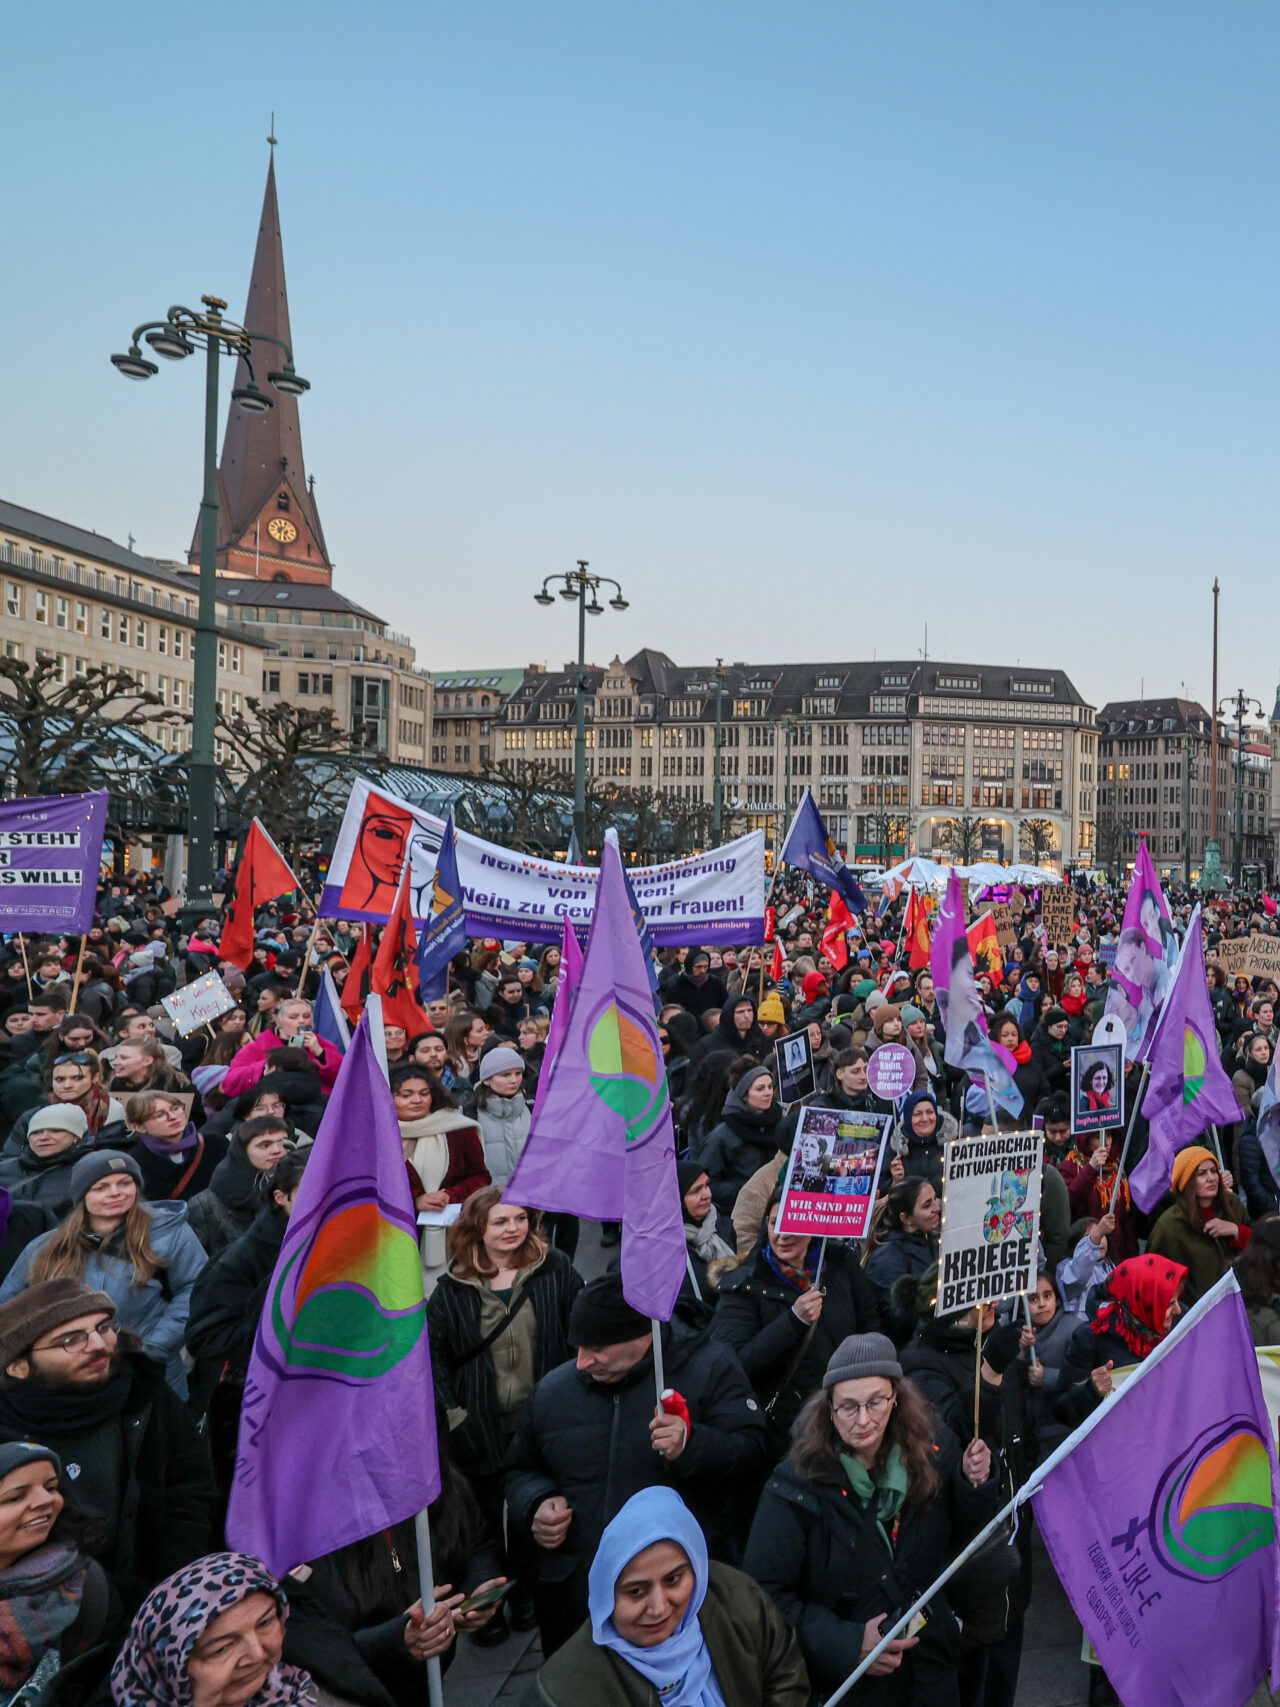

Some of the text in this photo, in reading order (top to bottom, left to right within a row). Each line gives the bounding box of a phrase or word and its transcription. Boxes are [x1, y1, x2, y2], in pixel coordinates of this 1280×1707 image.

[9, 832, 78, 845] STEHT
[20, 871, 80, 883] WILL!
[547, 887, 587, 900] von
[1043, 895, 1071, 904] UND
[461, 885, 510, 910] Nein
[518, 901, 546, 915] zu
[641, 904, 662, 917] an
[670, 895, 744, 915] Frauen!
[711, 921, 750, 929] Hamburg
[1043, 915, 1068, 925] DEM
[1221, 943, 1249, 957] RESPEC
[190, 1000, 221, 1020] Krieg
[951, 1136, 1041, 1162] PATRIARCHAT
[949, 1153, 1037, 1180] ENTWAFFNEN!
[790, 1199, 864, 1213] WIR SIND DIE
[787, 1210, 862, 1225] VERÄNDERUNG!
[944, 1237, 1032, 1284] KRIEGE
[942, 1267, 1029, 1310] BEENDEN
